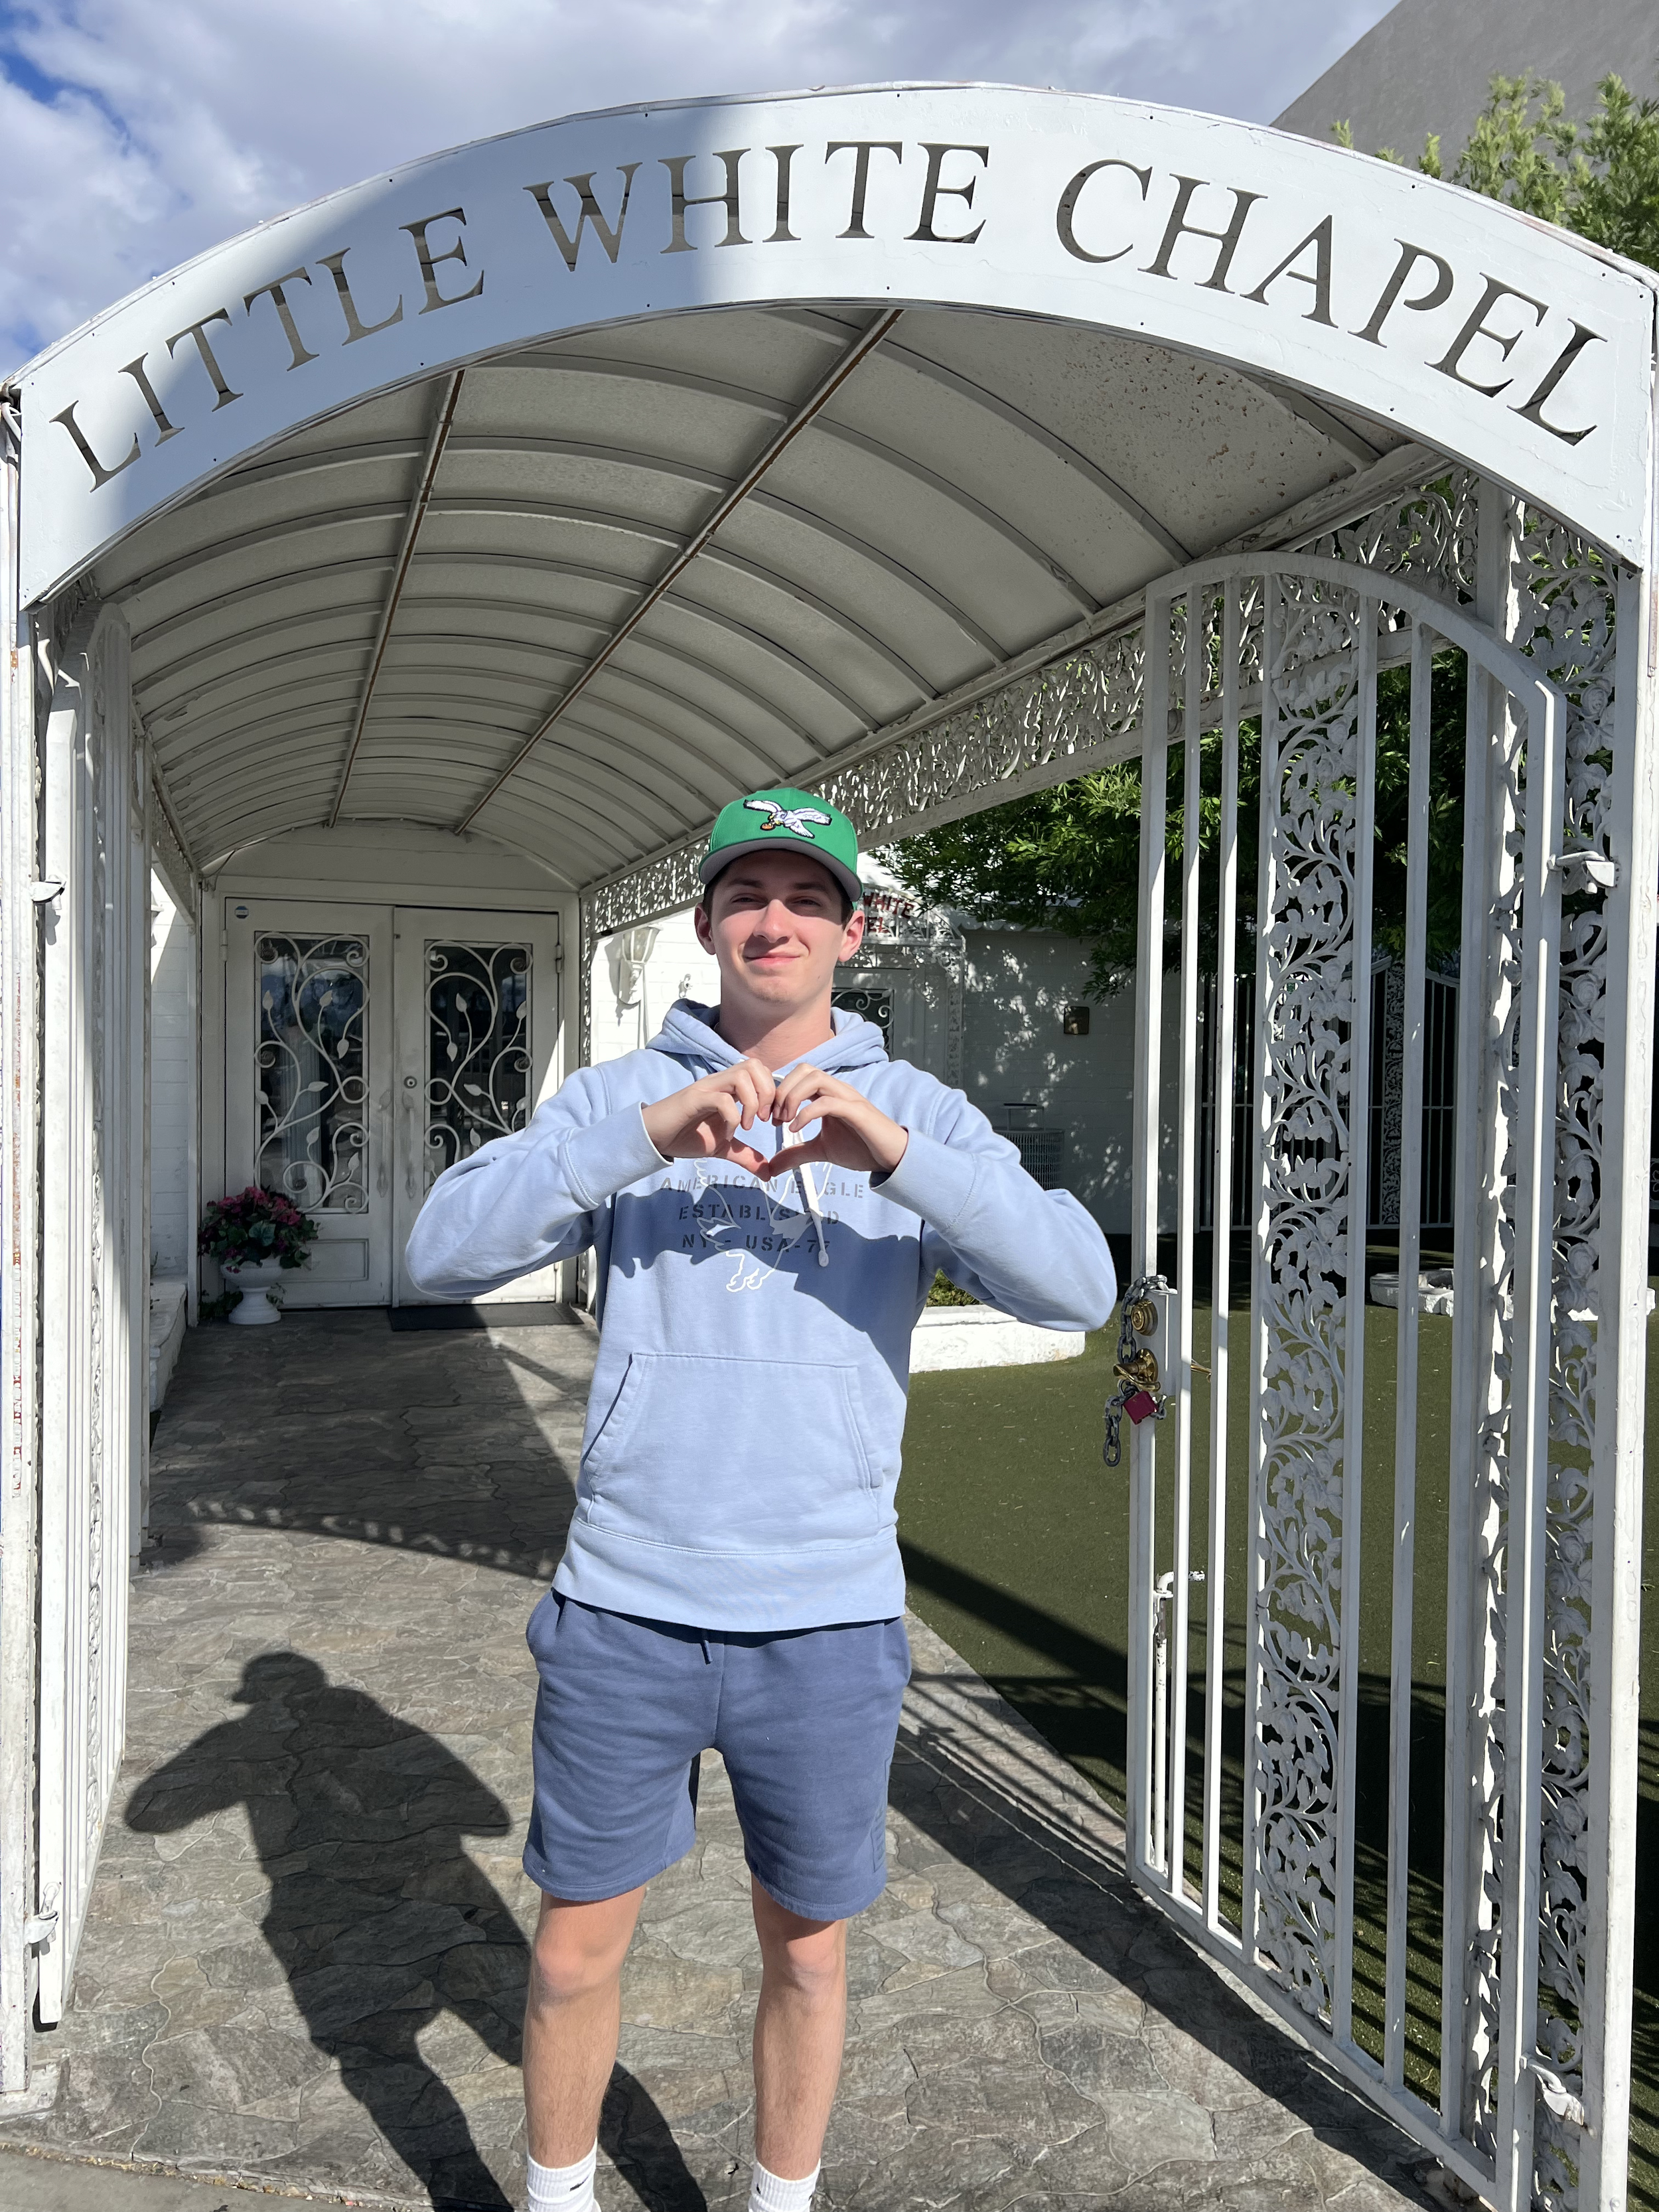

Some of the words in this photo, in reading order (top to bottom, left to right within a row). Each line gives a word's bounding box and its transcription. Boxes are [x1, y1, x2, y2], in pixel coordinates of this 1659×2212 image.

[50, 206, 486, 493] LITTLE
[522, 141, 990, 272] WHITE
[1056, 159, 1609, 447] CHAPEL
[660, 1175, 778, 1193] AMERICAN
[790, 1181, 863, 1199] EGLE
[682, 1234, 709, 1248] NY
